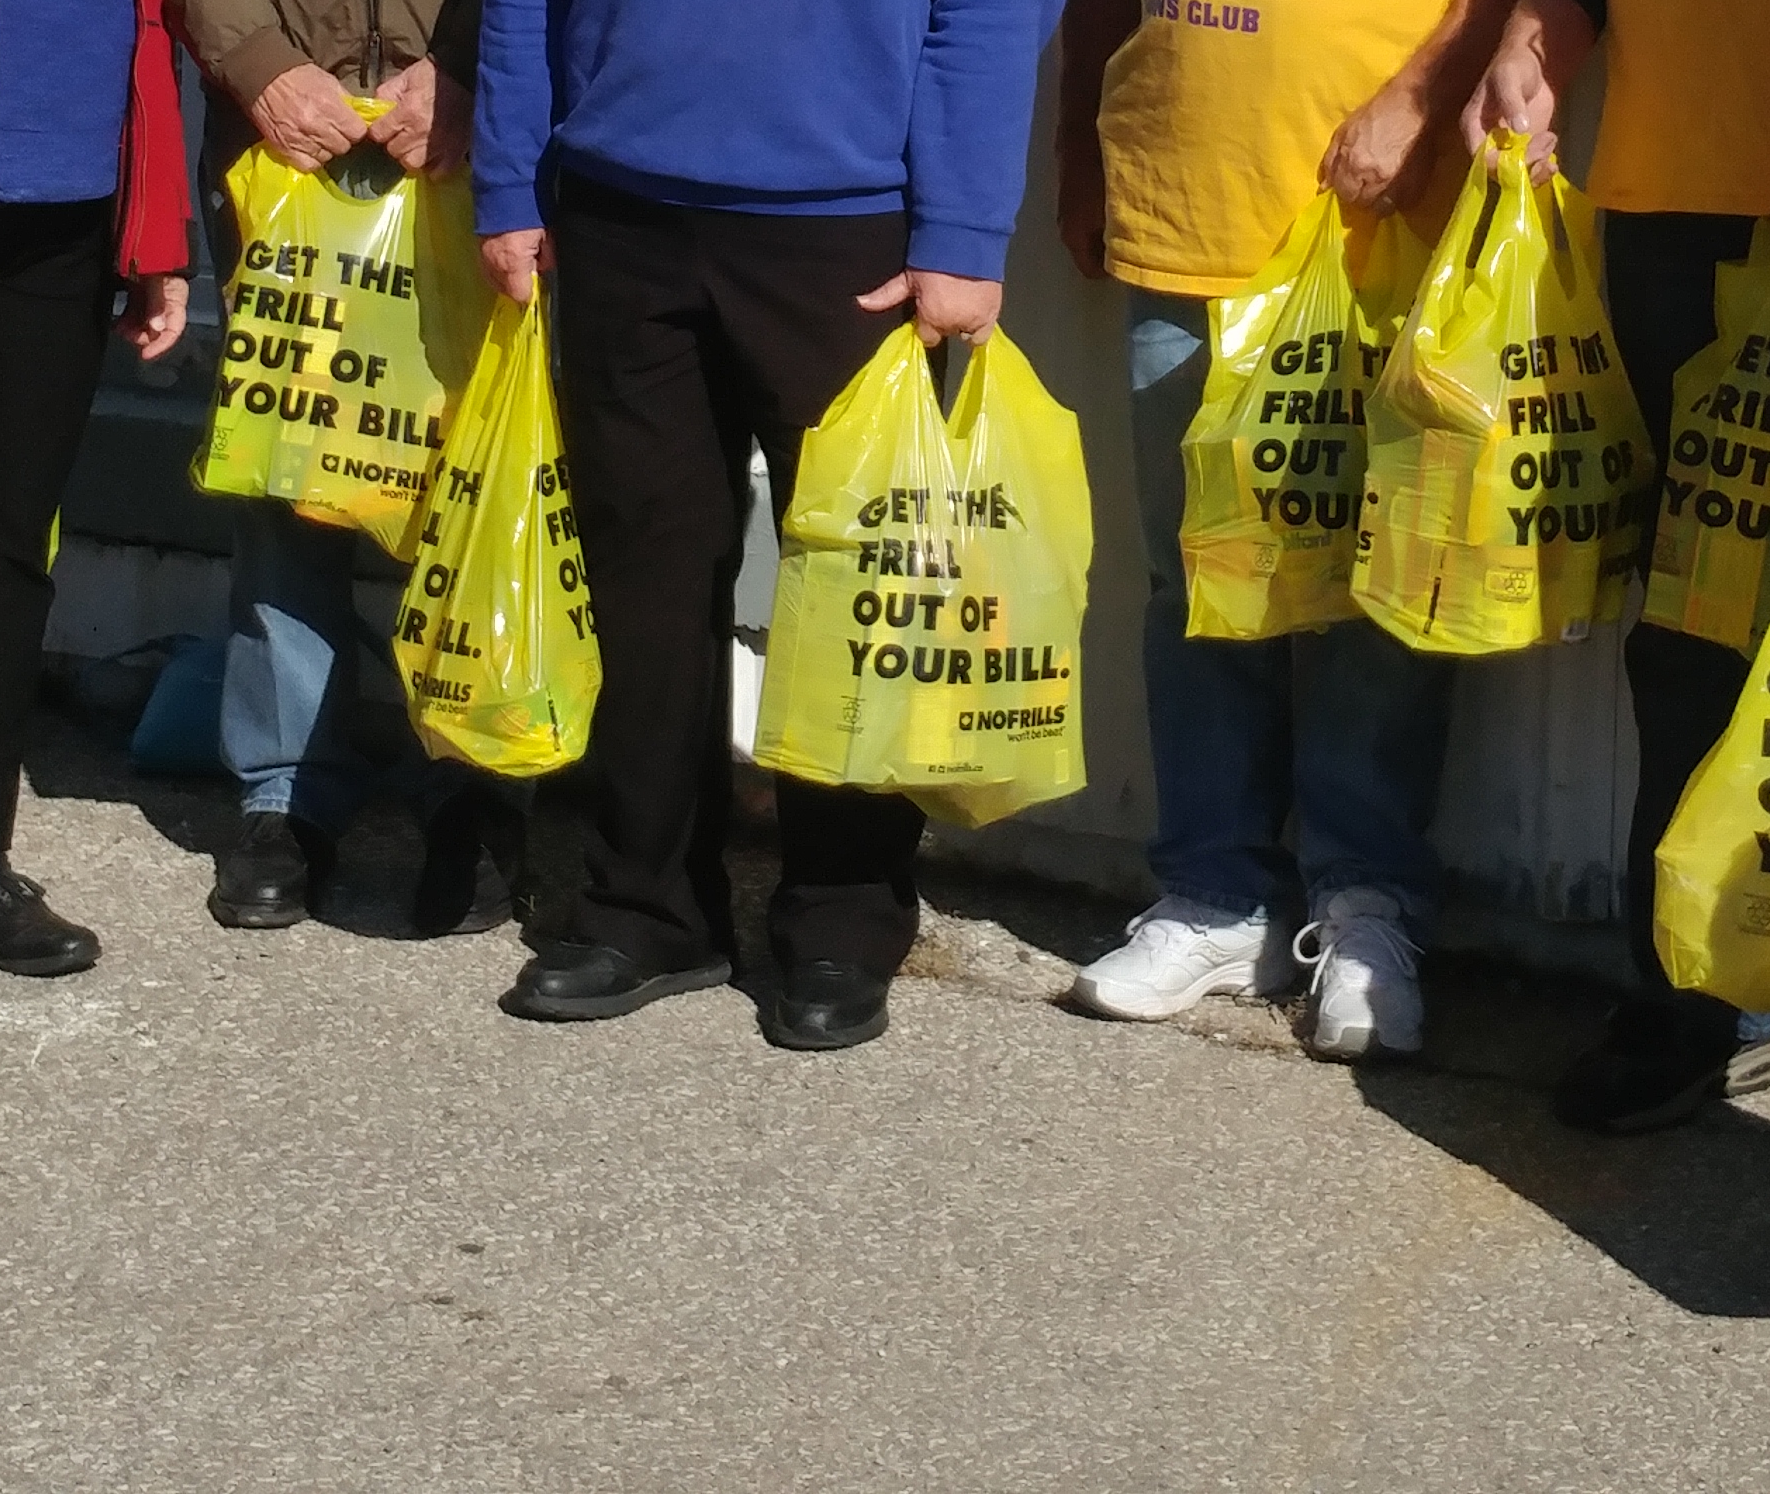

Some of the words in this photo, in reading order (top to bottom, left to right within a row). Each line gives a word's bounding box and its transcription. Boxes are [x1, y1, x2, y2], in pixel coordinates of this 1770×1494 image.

[1187, 0, 1260, 34] CLUB
[245, 239, 320, 277] GET
[337, 252, 414, 300] THE
[233, 281, 345, 332] FRILL
[225, 329, 314, 374] OUT
[329, 348, 388, 389] OF
[1271, 331, 1344, 376] GET
[1500, 334, 1559, 381] GET
[218, 373, 340, 430] YOUR
[1507, 390, 1597, 436] FRILL
[1252, 438, 1347, 477] OUT
[1510, 449, 1582, 490] OUT
[857, 487, 930, 528] GET
[947, 483, 1015, 530] THE
[857, 537, 962, 580] FRILL
[853, 590, 946, 631] OUT
[960, 595, 999, 633] OF
[846, 639, 973, 684] YOUR
[984, 645, 1070, 684] BILL.
[977, 705, 1066, 731] NOFRILLS
